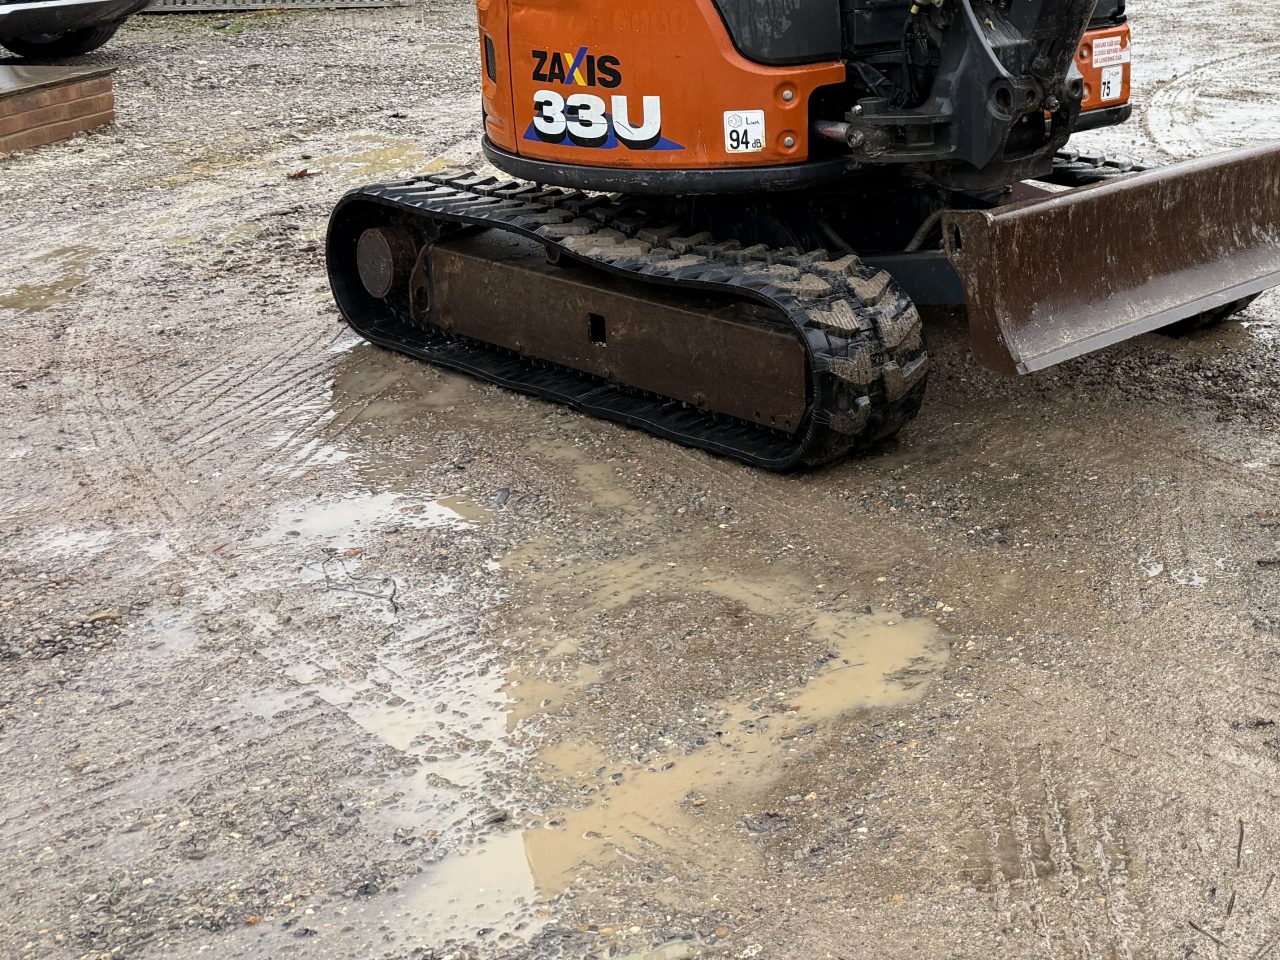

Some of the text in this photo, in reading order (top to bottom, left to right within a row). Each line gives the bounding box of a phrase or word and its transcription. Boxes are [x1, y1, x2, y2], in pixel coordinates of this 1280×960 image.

[532, 46, 622, 88] ZAXIS
[1102, 80, 1110, 97] 75
[532, 89, 662, 151] 33U
[729, 129, 762, 150] 94 dB
